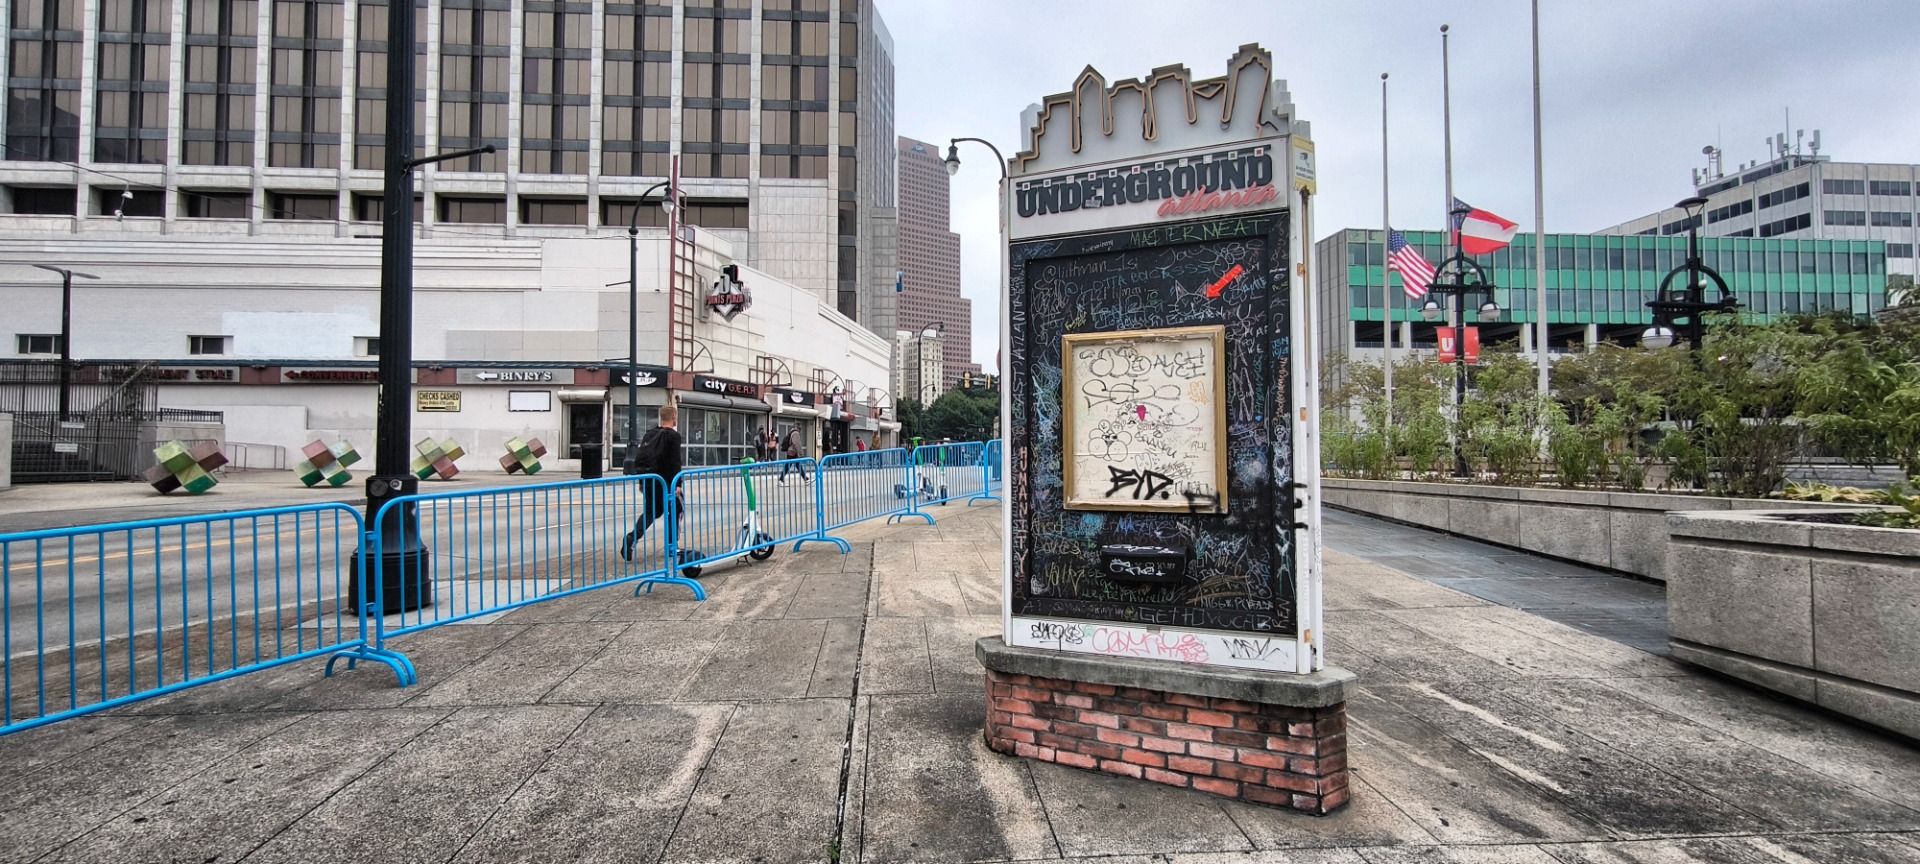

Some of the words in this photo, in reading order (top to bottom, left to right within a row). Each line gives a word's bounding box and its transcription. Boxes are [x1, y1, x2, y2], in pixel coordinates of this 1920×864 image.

[1016, 152, 1273, 218] UNDERGROUND
[1157, 183, 1280, 217] atlanta
[1203, 218, 1270, 240] MEAT
[1441, 337, 1454, 352] U
[500, 371, 552, 382] BINKY'S
[705, 379, 727, 392] city
[418, 392, 439, 401] CHECKS
[440, 392, 460, 401] CASHED
